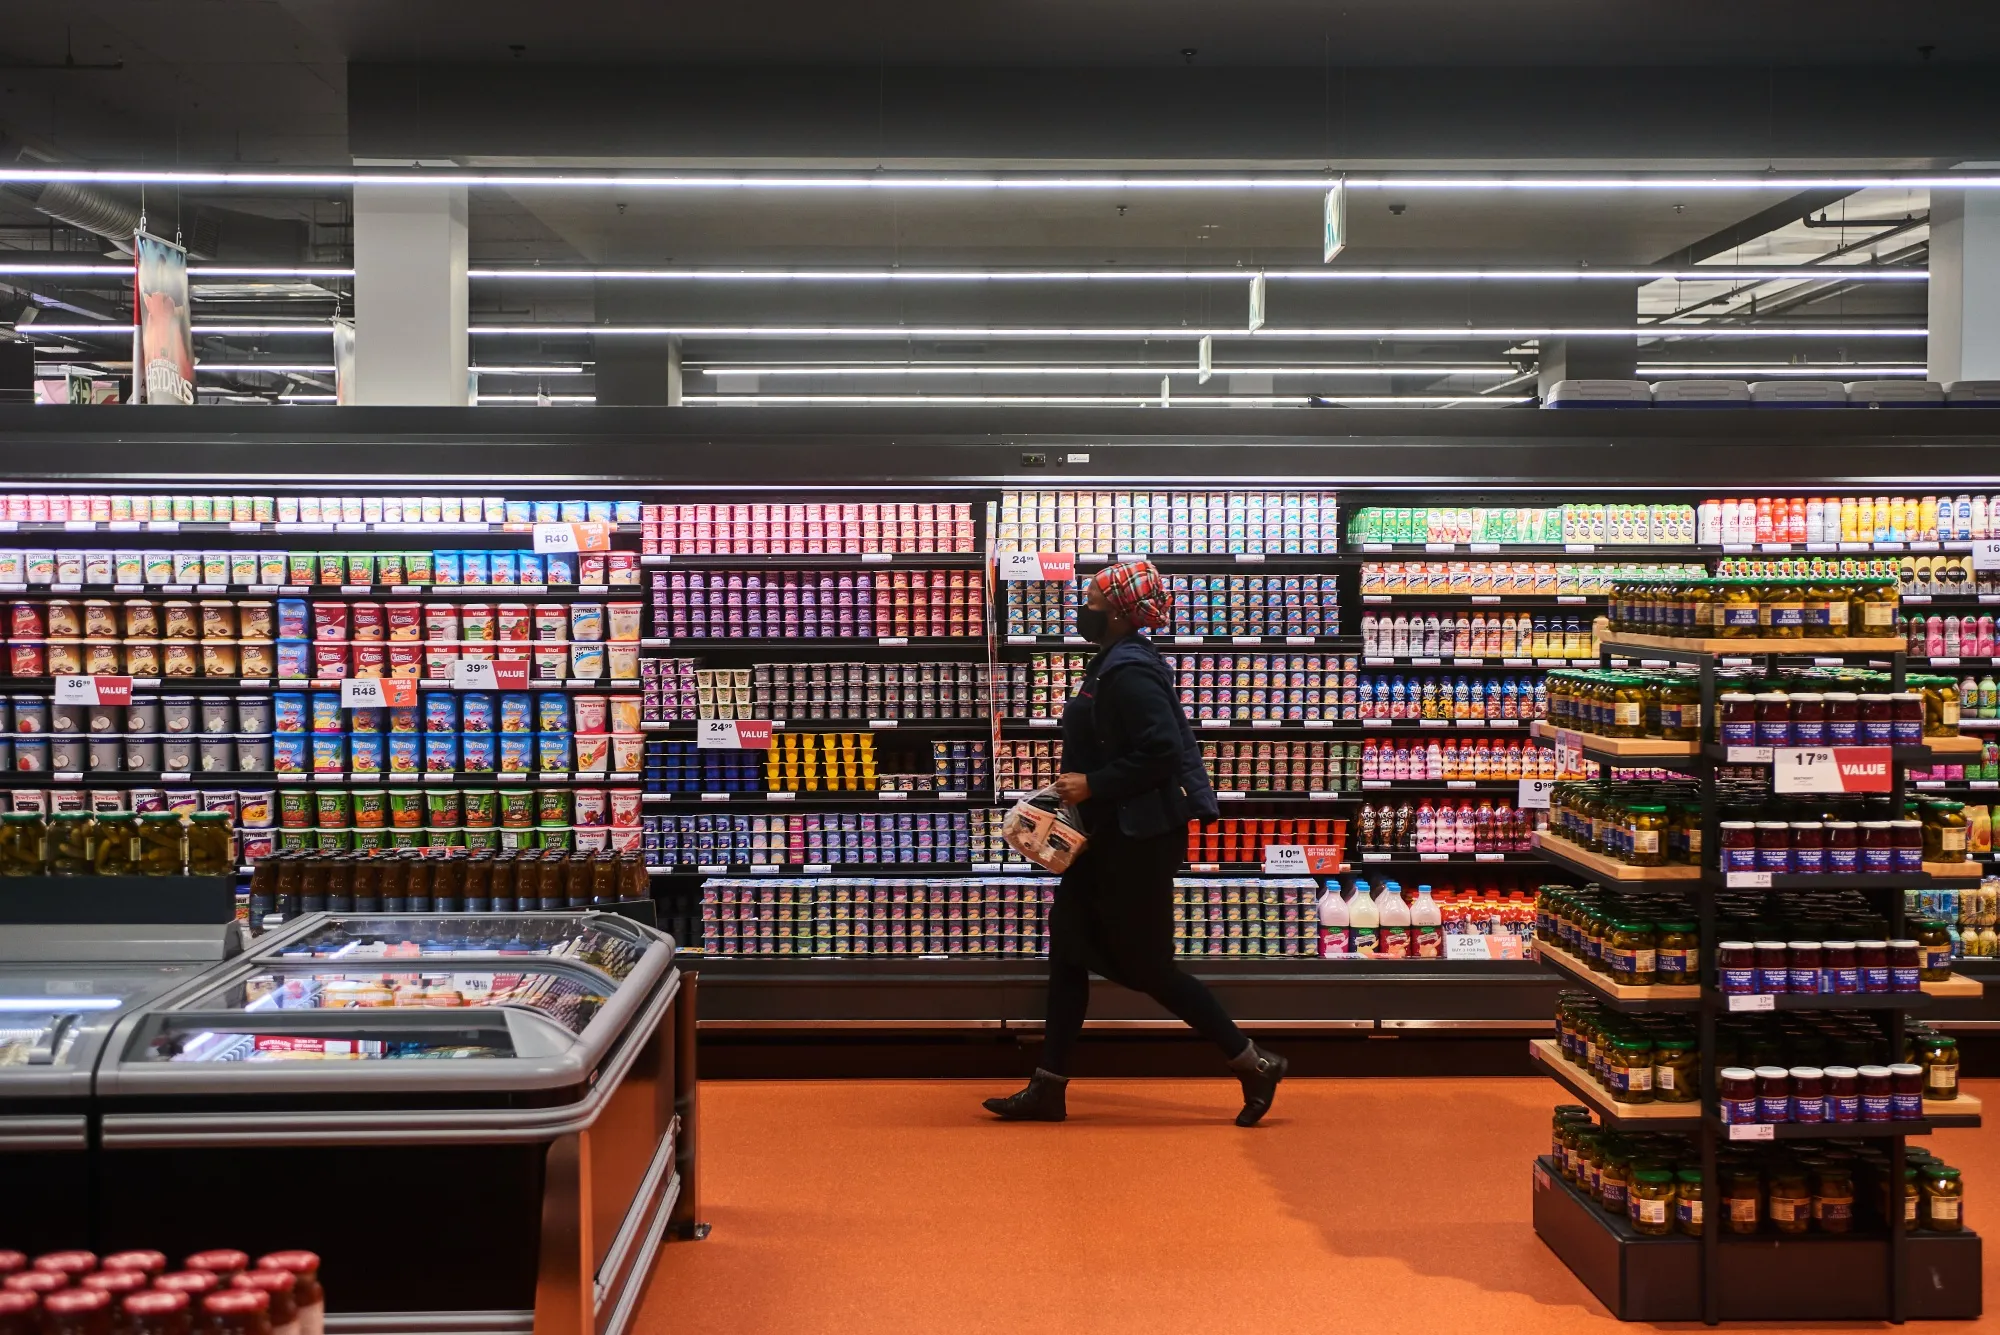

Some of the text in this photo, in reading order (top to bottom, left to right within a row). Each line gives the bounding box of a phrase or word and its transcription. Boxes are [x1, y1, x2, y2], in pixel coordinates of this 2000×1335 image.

[147, 363, 194, 405] HEYDAYS
[545, 535, 568, 543] R40
[1043, 562, 1070, 570] VALUE
[1842, 764, 1886, 775] VALUE
